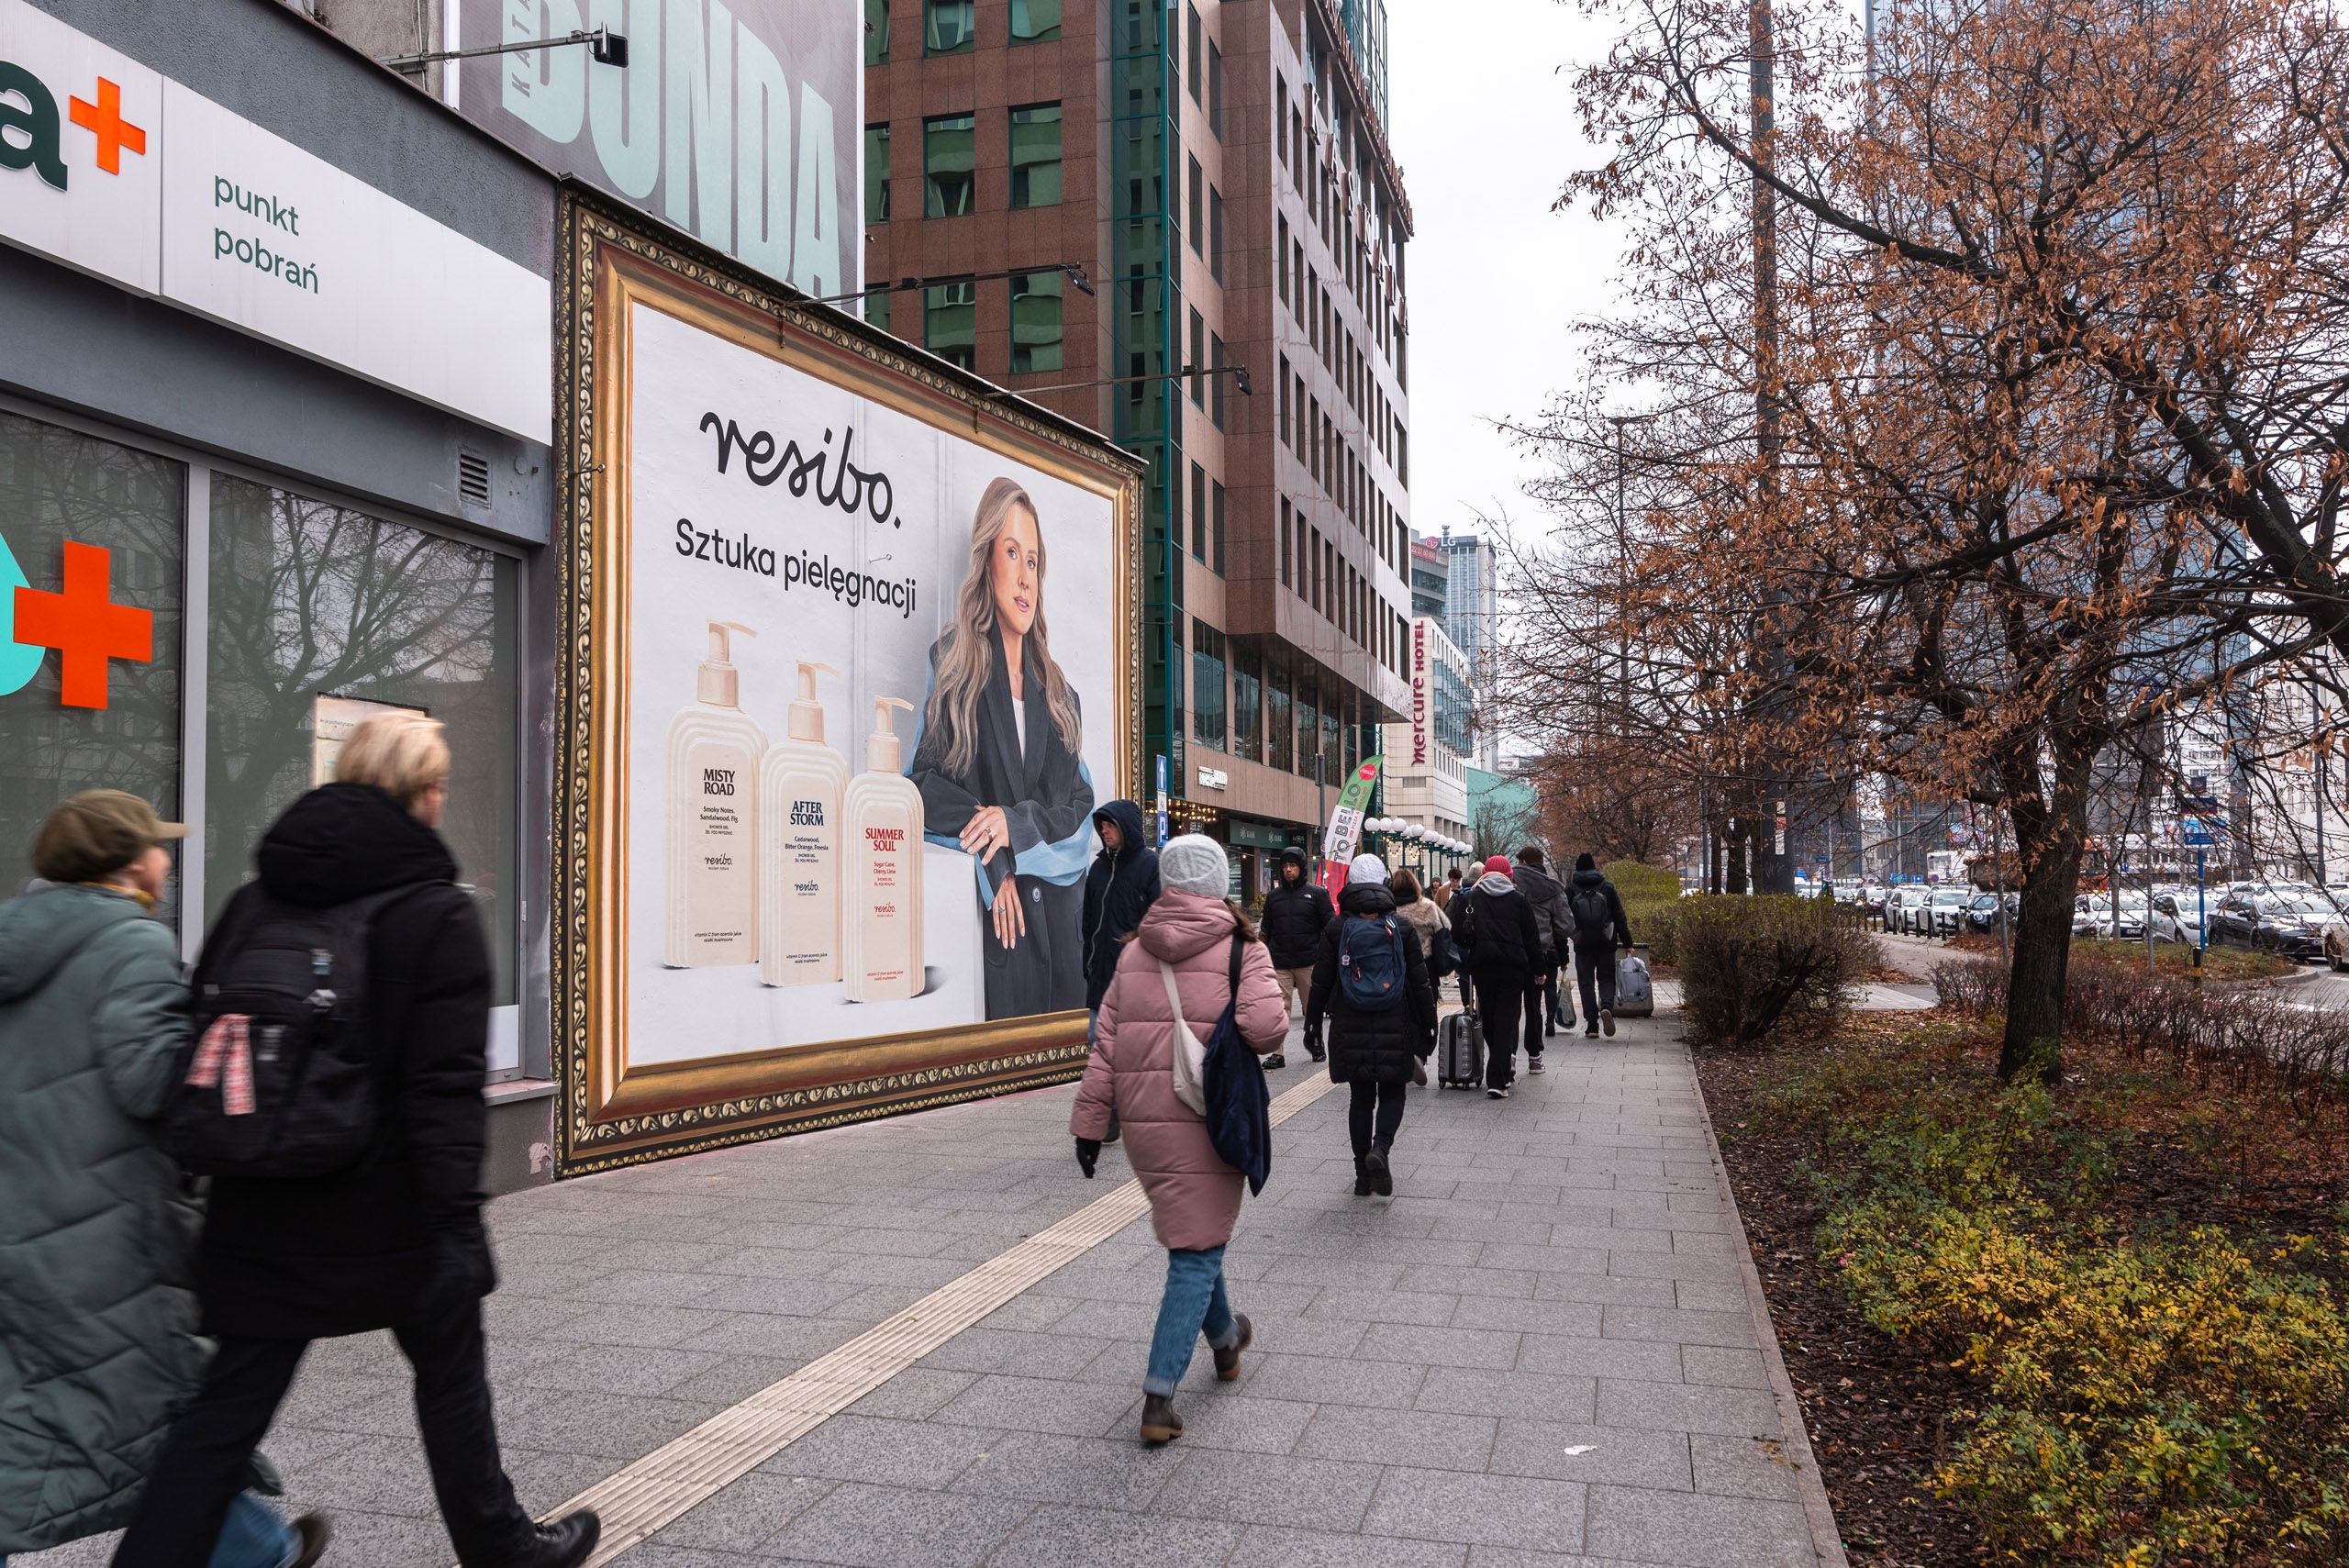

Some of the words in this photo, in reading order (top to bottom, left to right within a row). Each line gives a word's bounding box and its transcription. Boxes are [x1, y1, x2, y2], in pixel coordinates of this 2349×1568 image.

[214, 174, 300, 237] punkt
[214, 227, 318, 295] pobrań
[699, 411, 902, 530] resibo.
[1442, 537, 1456, 547] LG
[675, 517, 775, 577] Sztuka
[784, 549, 916, 619] pielęgnacji
[1414, 620, 1424, 672] HOTEL
[703, 768, 736, 783] MISTY
[704, 782, 735, 796] ROAD
[703, 806, 719, 814] Smoky
[792, 800, 823, 814] AFTER
[730, 816, 739, 824] Fig
[790, 813, 824, 827] STORM
[865, 828, 905, 841] SUMMER
[873, 840, 896, 852] SOUL
